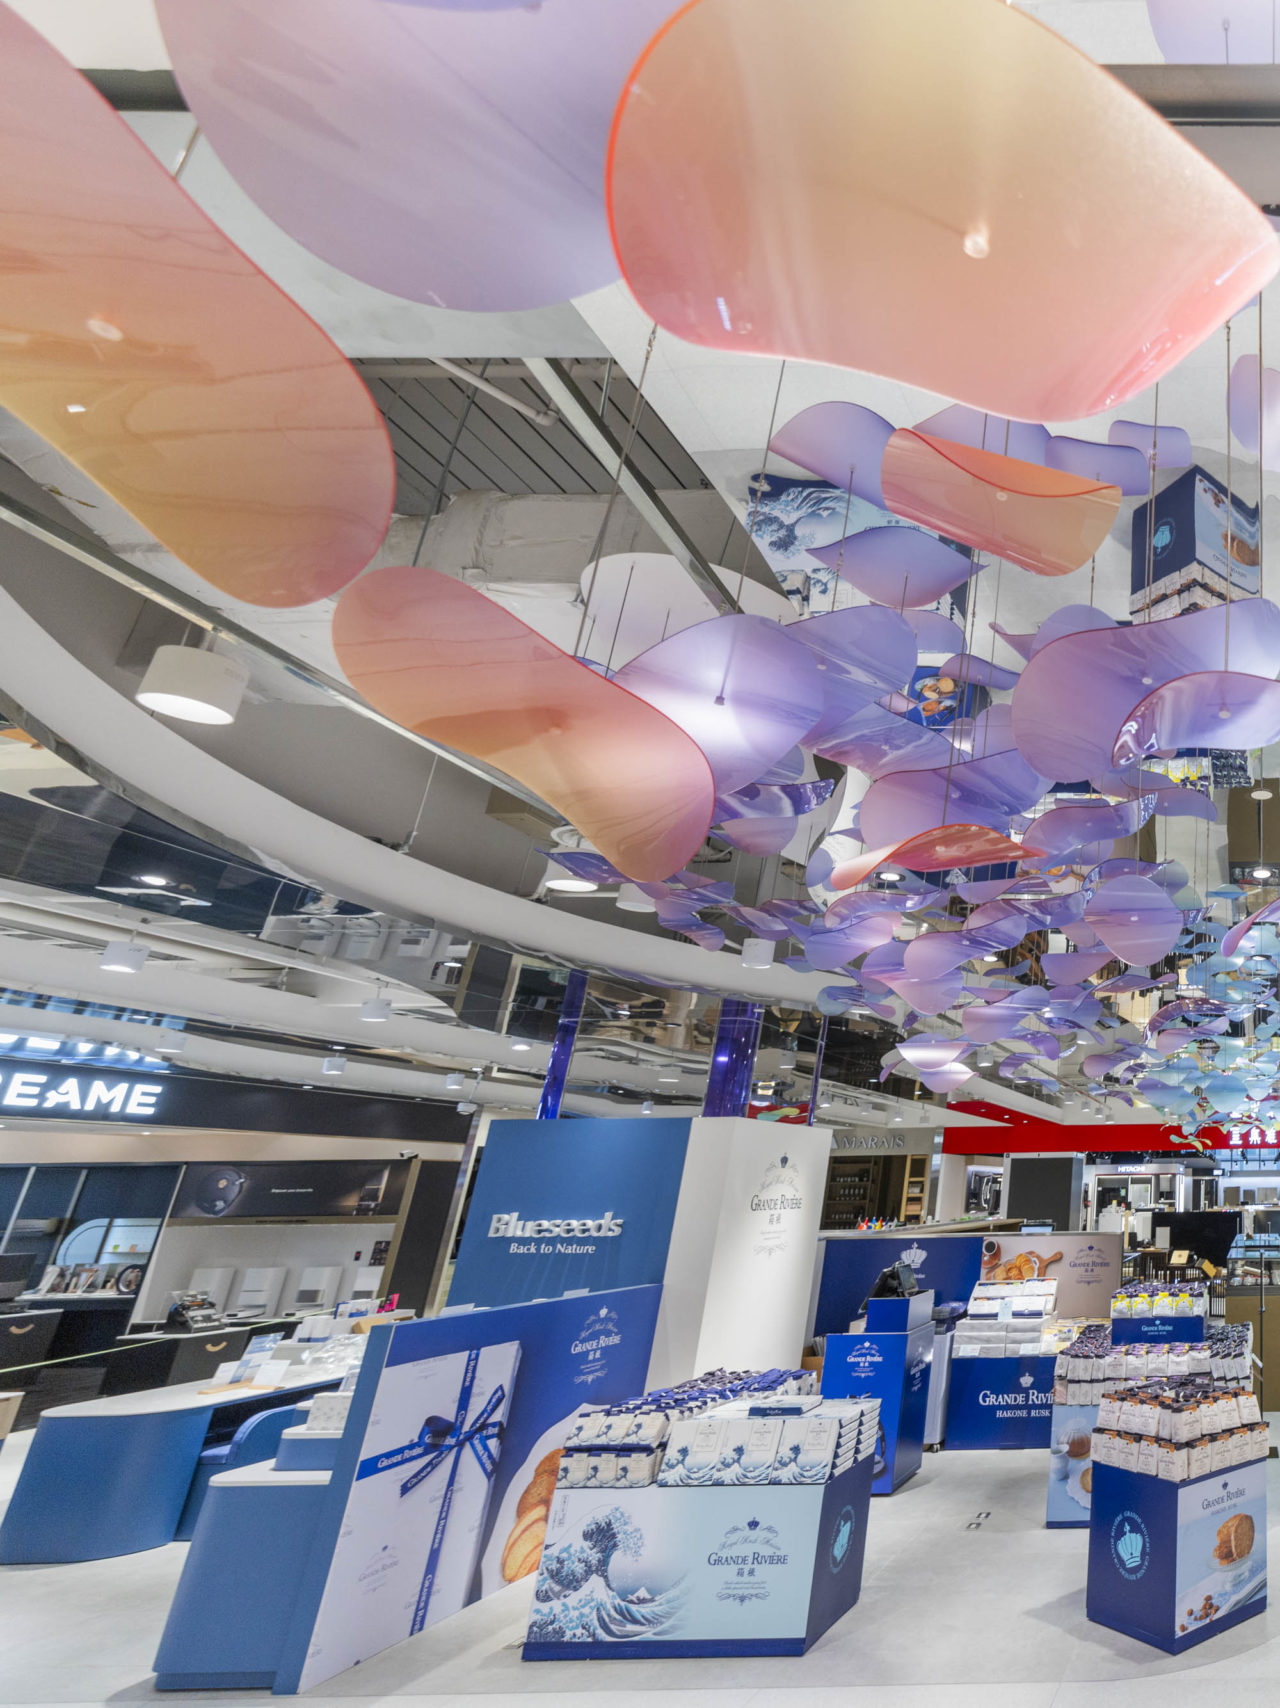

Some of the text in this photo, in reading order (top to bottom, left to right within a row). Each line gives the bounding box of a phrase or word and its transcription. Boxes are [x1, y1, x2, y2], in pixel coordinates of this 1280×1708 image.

[0, 1073, 163, 1115] EAME
[1118, 1165, 1146, 1173] HITACHI
[488, 1211, 624, 1238] Blueseeds
[510, 1242, 596, 1254] Back to Nature
[979, 1389, 1054, 1406] GRANDE RIVI
[996, 1409, 1051, 1418] HAKONE RUSK
[1202, 1494, 1225, 1510] GRANDE
[707, 1551, 789, 1566] GRANDE RIVIÈRE
